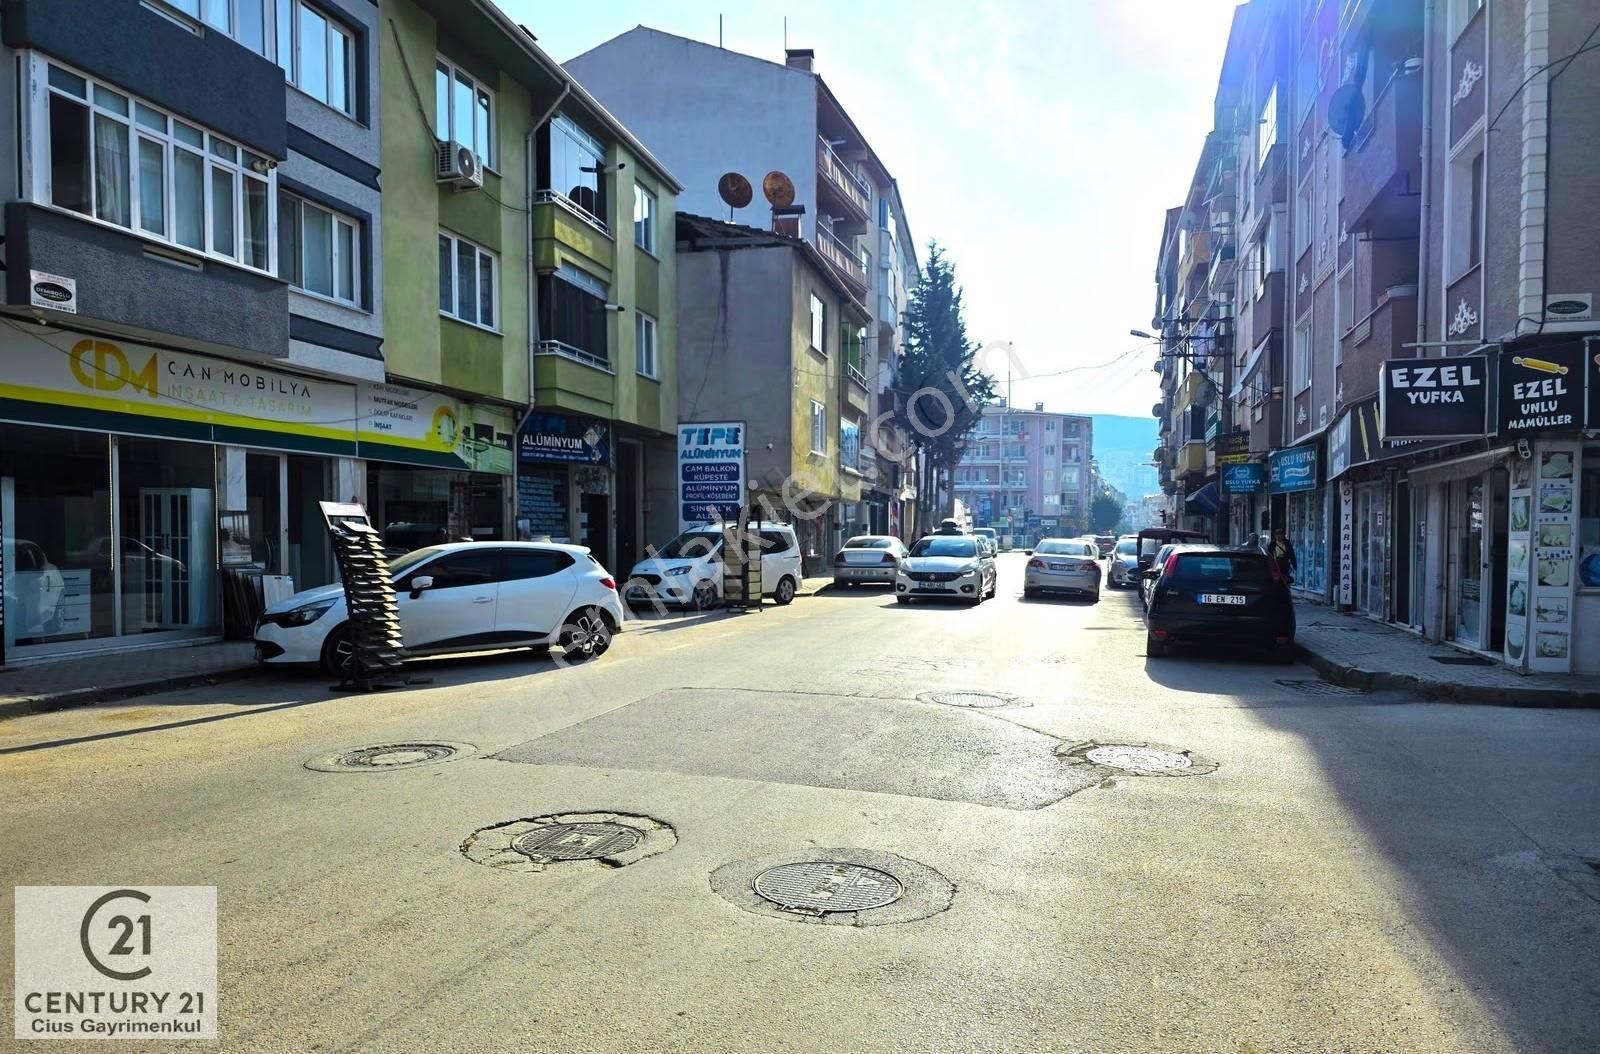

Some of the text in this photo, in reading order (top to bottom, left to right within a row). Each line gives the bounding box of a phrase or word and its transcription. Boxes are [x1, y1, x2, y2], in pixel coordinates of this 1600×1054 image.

[69, 339, 158, 398] CDM
[168, 360, 211, 380] CAN
[1391, 365, 1481, 388] EZEL
[1512, 378, 1568, 400] EZEL
[1406, 390, 1465, 405] YUFKA
[1521, 400, 1558, 415] UNLU
[1507, 414, 1573, 430] MAMÜLLER
[522, 432, 583, 449] ALÜMİNYUM
[681, 426, 742, 446] TEPE
[680, 447, 742, 460] ALÜMİNYUM
[705, 465, 737, 473] BALKON
[693, 472, 729, 482] KÜPEŞTE
[685, 483, 738, 492] ALÜMİNYUM
[1204, 595, 1212, 603] 16
[1230, 596, 1244, 604] 215
